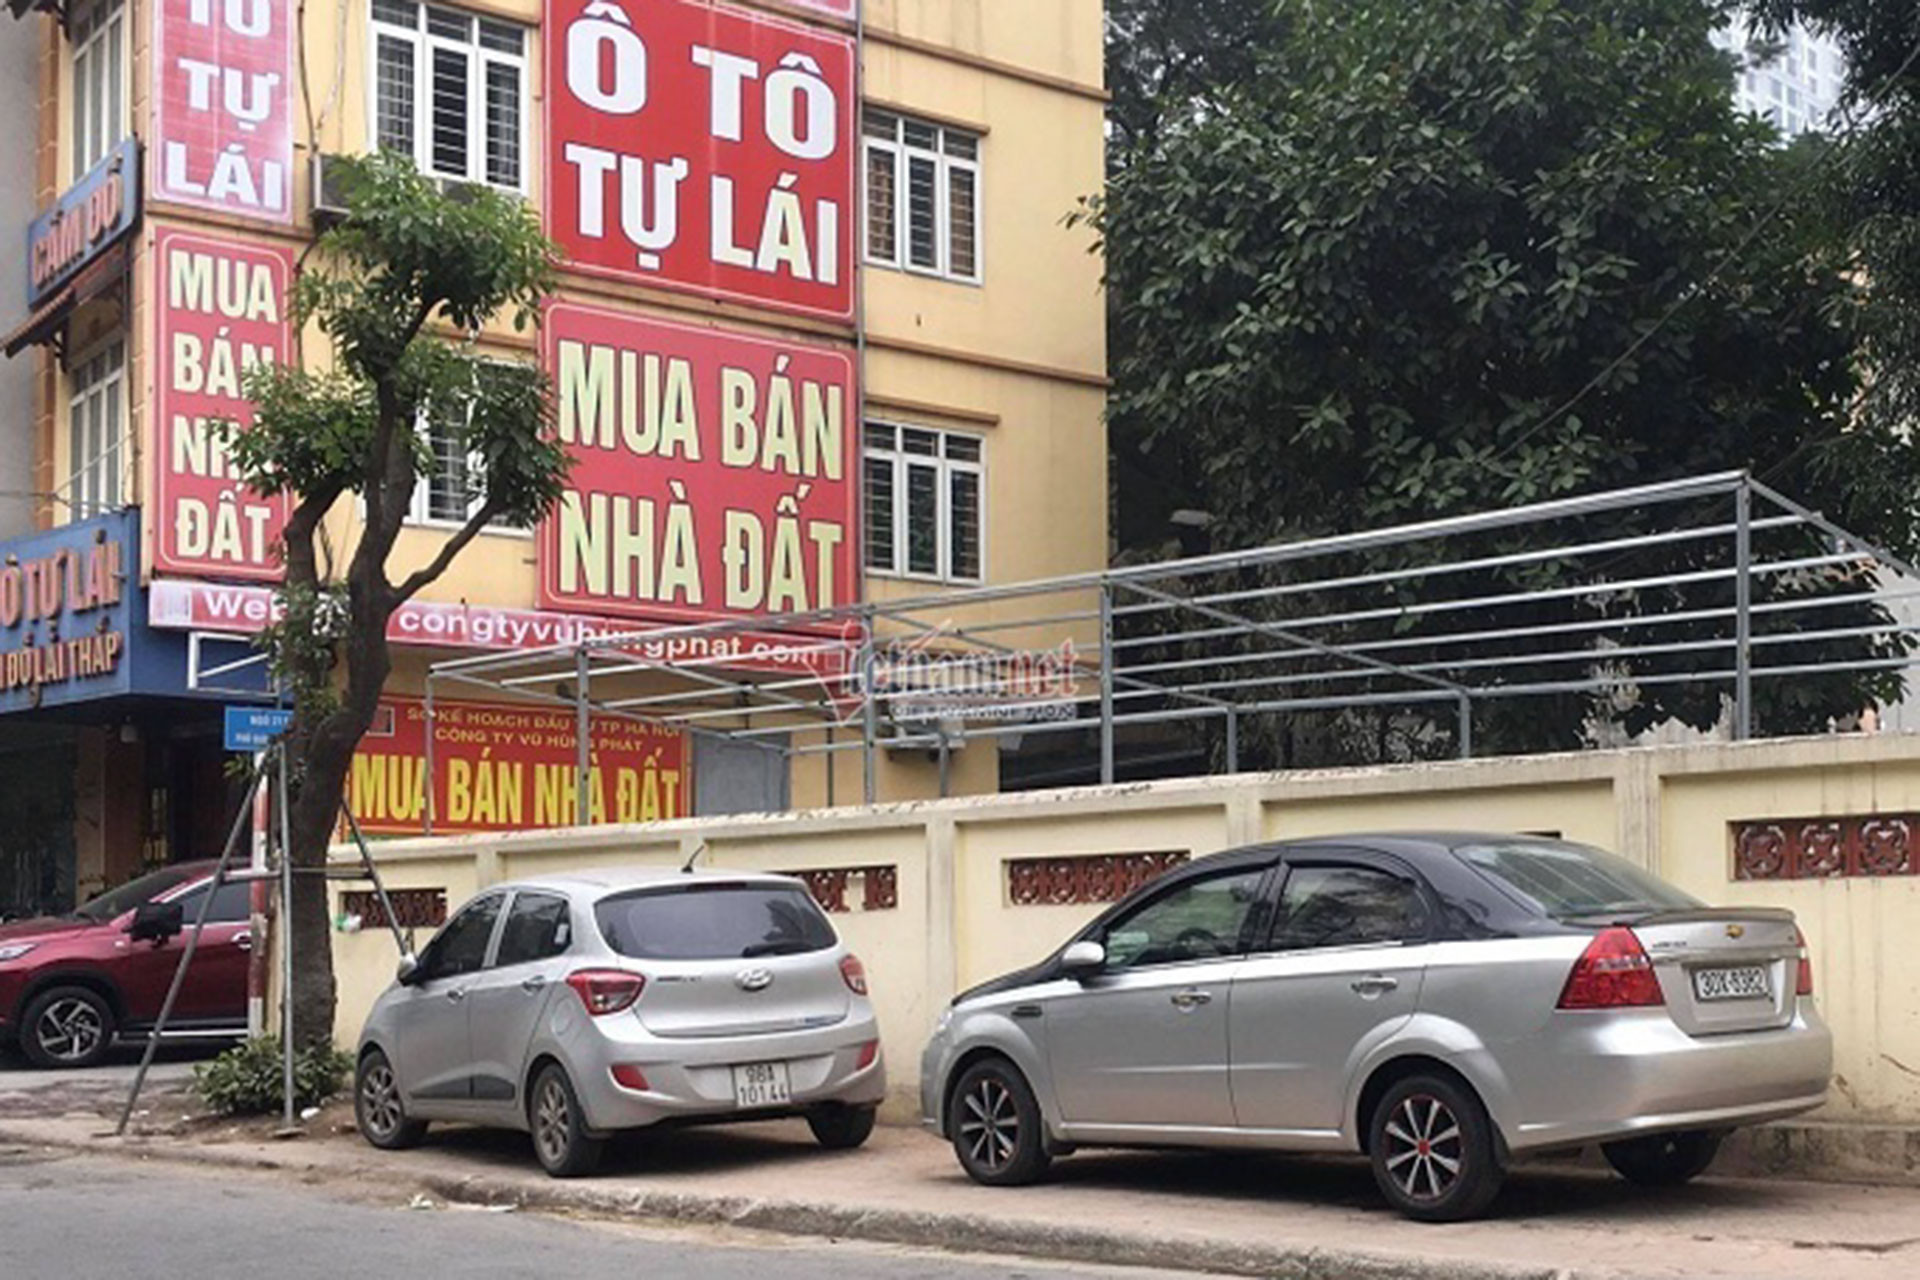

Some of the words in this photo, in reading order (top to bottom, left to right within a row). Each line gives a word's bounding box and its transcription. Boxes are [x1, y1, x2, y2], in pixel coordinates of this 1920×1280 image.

[178, 58, 280, 130] TỰ
[567, 1, 646, 115] Ô
[692, 44, 837, 160] TÔ
[165, 142, 282, 209] LÁI
[565, 142, 689, 270] TỰ
[711, 171, 838, 286] LÁI
[170, 250, 278, 325] MUA
[173, 414, 275, 479] NH
[558, 340, 701, 461] MUA
[721, 355, 841, 480] BÁN
[175, 483, 271, 563] ĐẤT
[558, 480, 702, 604] NHÀ
[721, 484, 842, 613] ĐẤT
[352, 754, 436, 821] MUA
[449, 747, 521, 824] BÁN
[617, 748, 679, 824] ĐẤT
